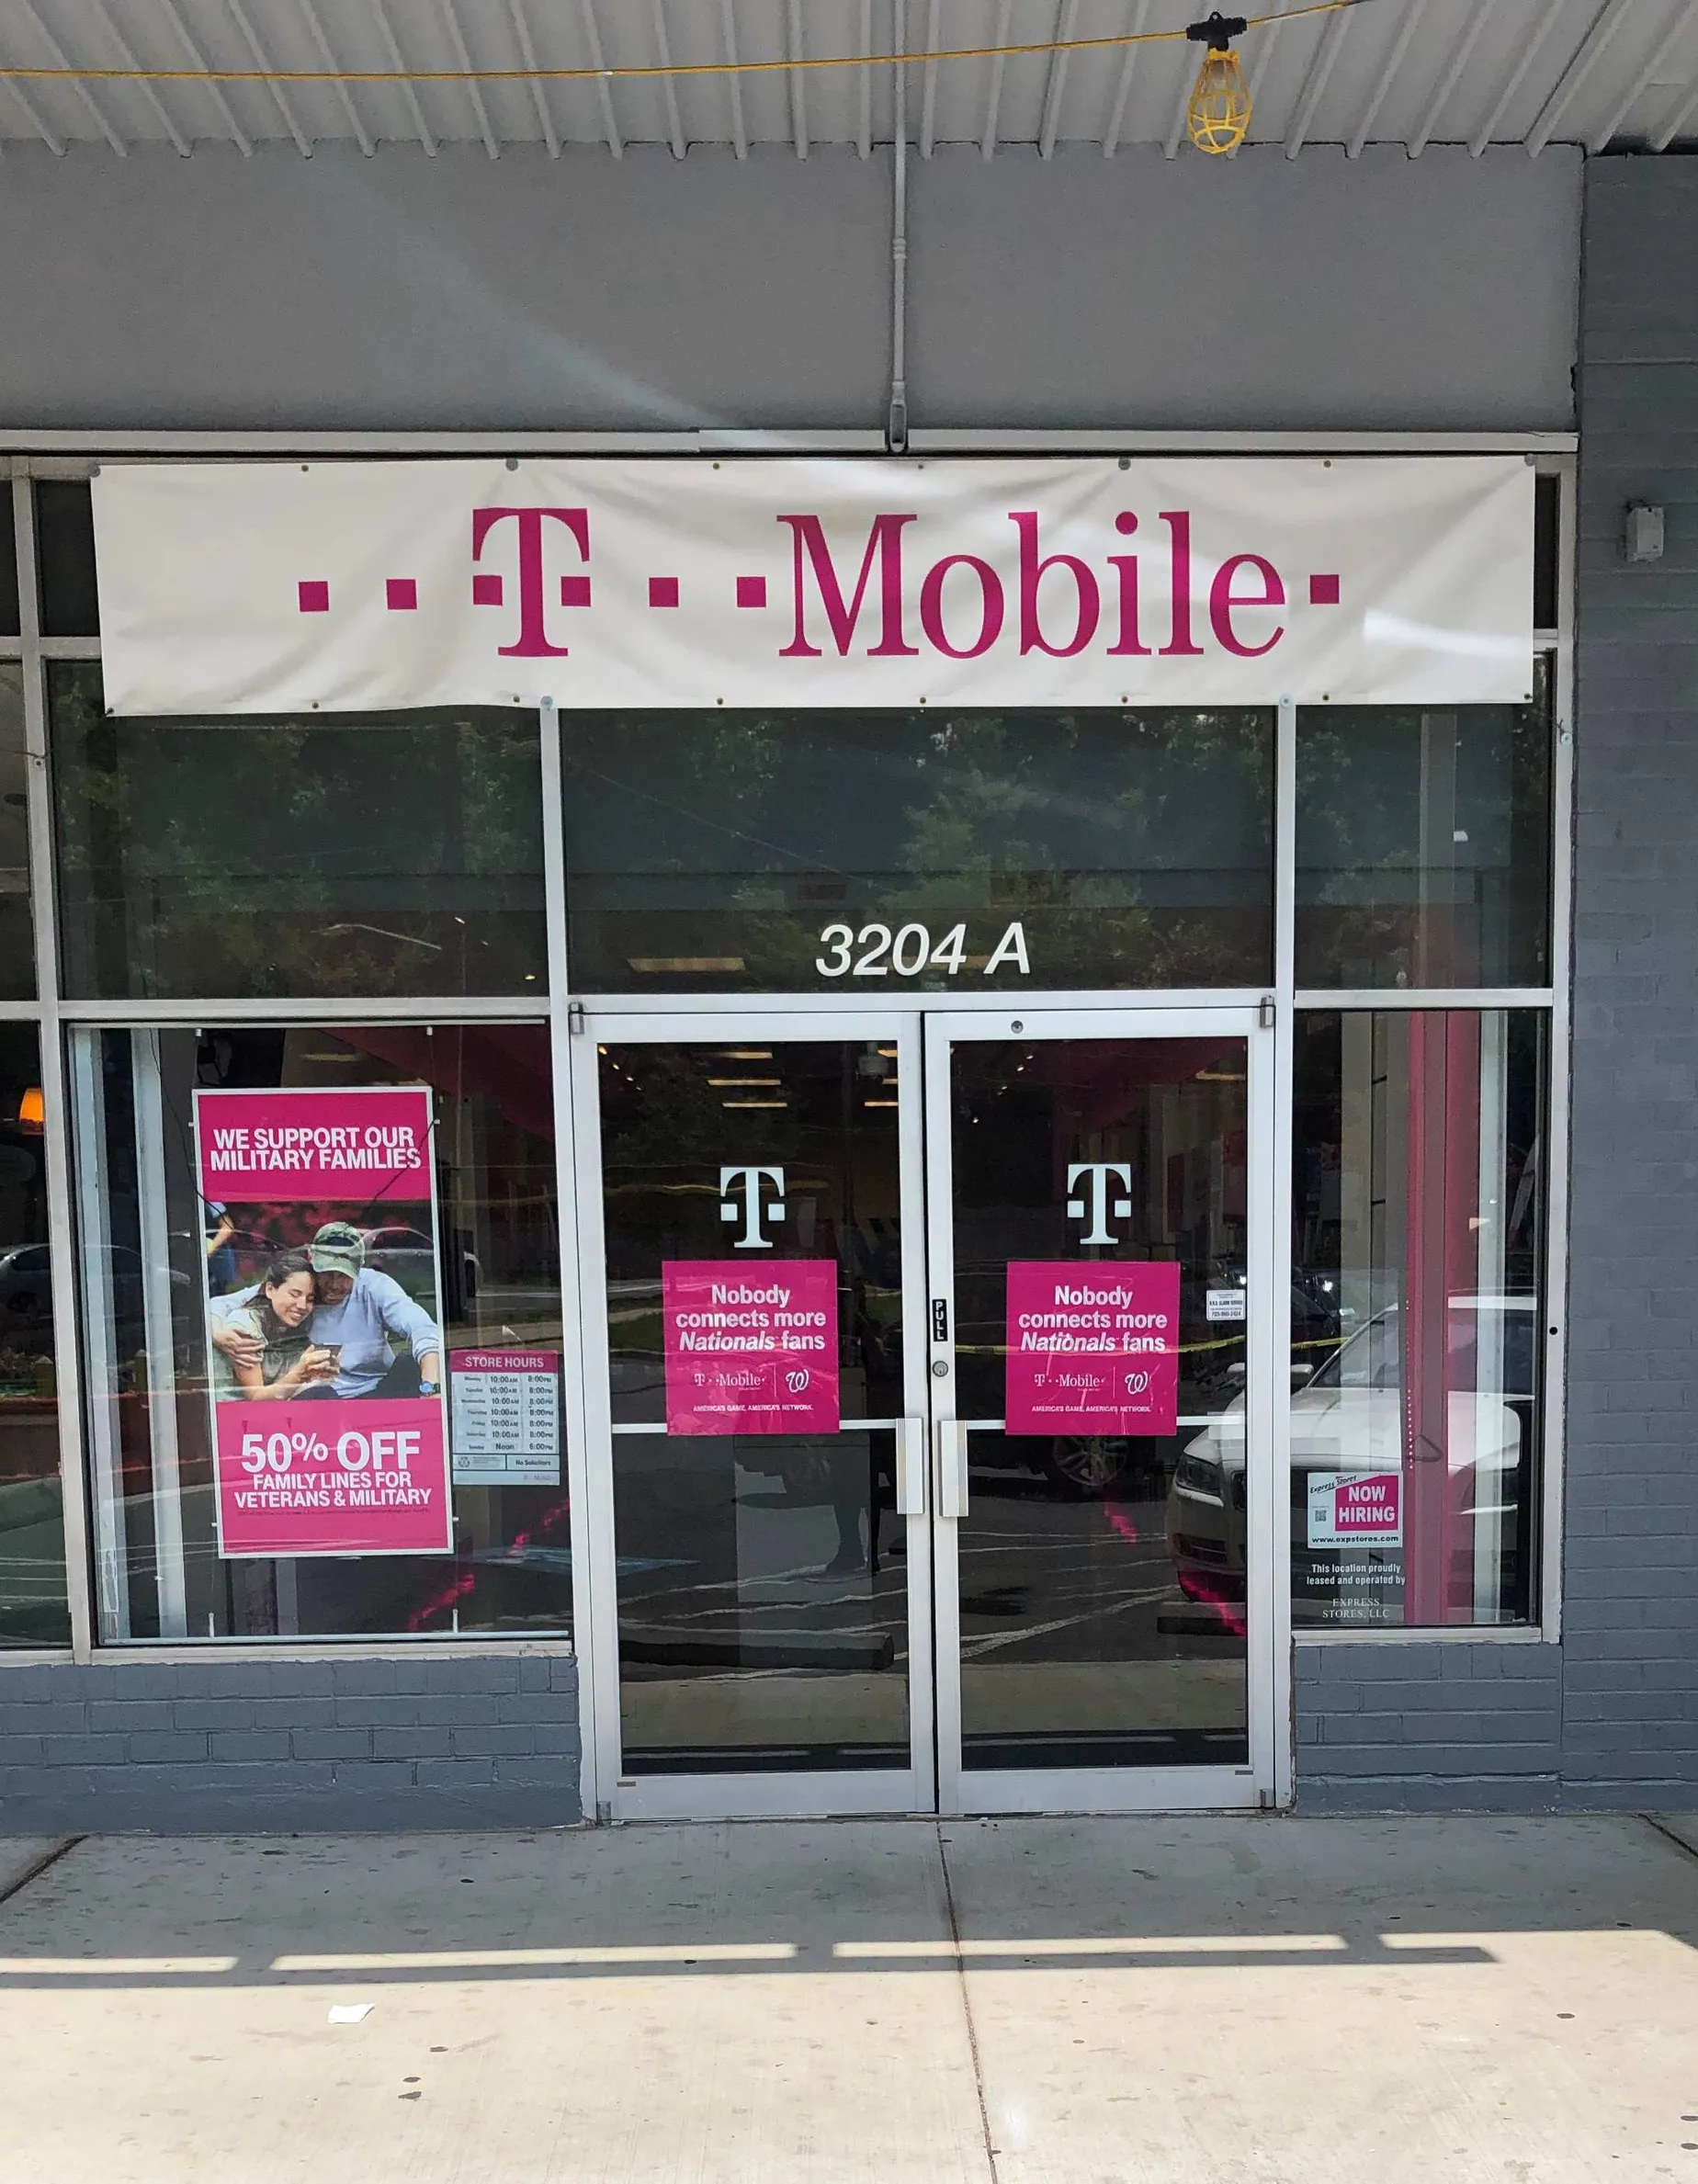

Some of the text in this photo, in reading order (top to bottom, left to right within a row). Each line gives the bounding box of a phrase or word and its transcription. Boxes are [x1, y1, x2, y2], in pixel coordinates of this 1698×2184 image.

[776, 511, 1286, 660] Mobile
[816, 922, 1030, 977] 3204 A
[213, 1126, 414, 1149] WE SUPPORT OUR
[210, 1148, 422, 1171] MILITARY FAMILIES
[720, 1167, 786, 1248] T
[1068, 1163, 1131, 1244] T
[711, 1284, 790, 1308] Nobody
[1055, 1284, 1133, 1309] Nobody
[675, 1309, 826, 1329] connects more
[935, 1300, 945, 1341] PULL
[1018, 1310, 1167, 1329] connects more
[679, 1330, 826, 1352] Nationals fans
[1021, 1331, 1166, 1352] Nationals fans
[465, 1356, 545, 1368] STORE HOURS
[719, 1373, 762, 1386] Mobile
[1058, 1374, 1101, 1387] Mobile
[242, 1431, 421, 1473] 50% OFF
[495, 1443, 515, 1451] Noon
[253, 1471, 412, 1491] FAMILY LINES FOR
[1310, 1475, 1357, 1495] Express Stores
[234, 1488, 432, 1509] VETERANS & MILITARY
[1348, 1486, 1387, 1502] NOW
[1339, 1506, 1396, 1523] HIRING
[1312, 1535, 1398, 1544] www.expstores.com
[1311, 1563, 1401, 1575] This location proudly
[1307, 1575, 1406, 1587] leased and operated by
[1332, 1597, 1380, 1608] EXPRESS
[1369, 1609, 1390, 1619] LLC
